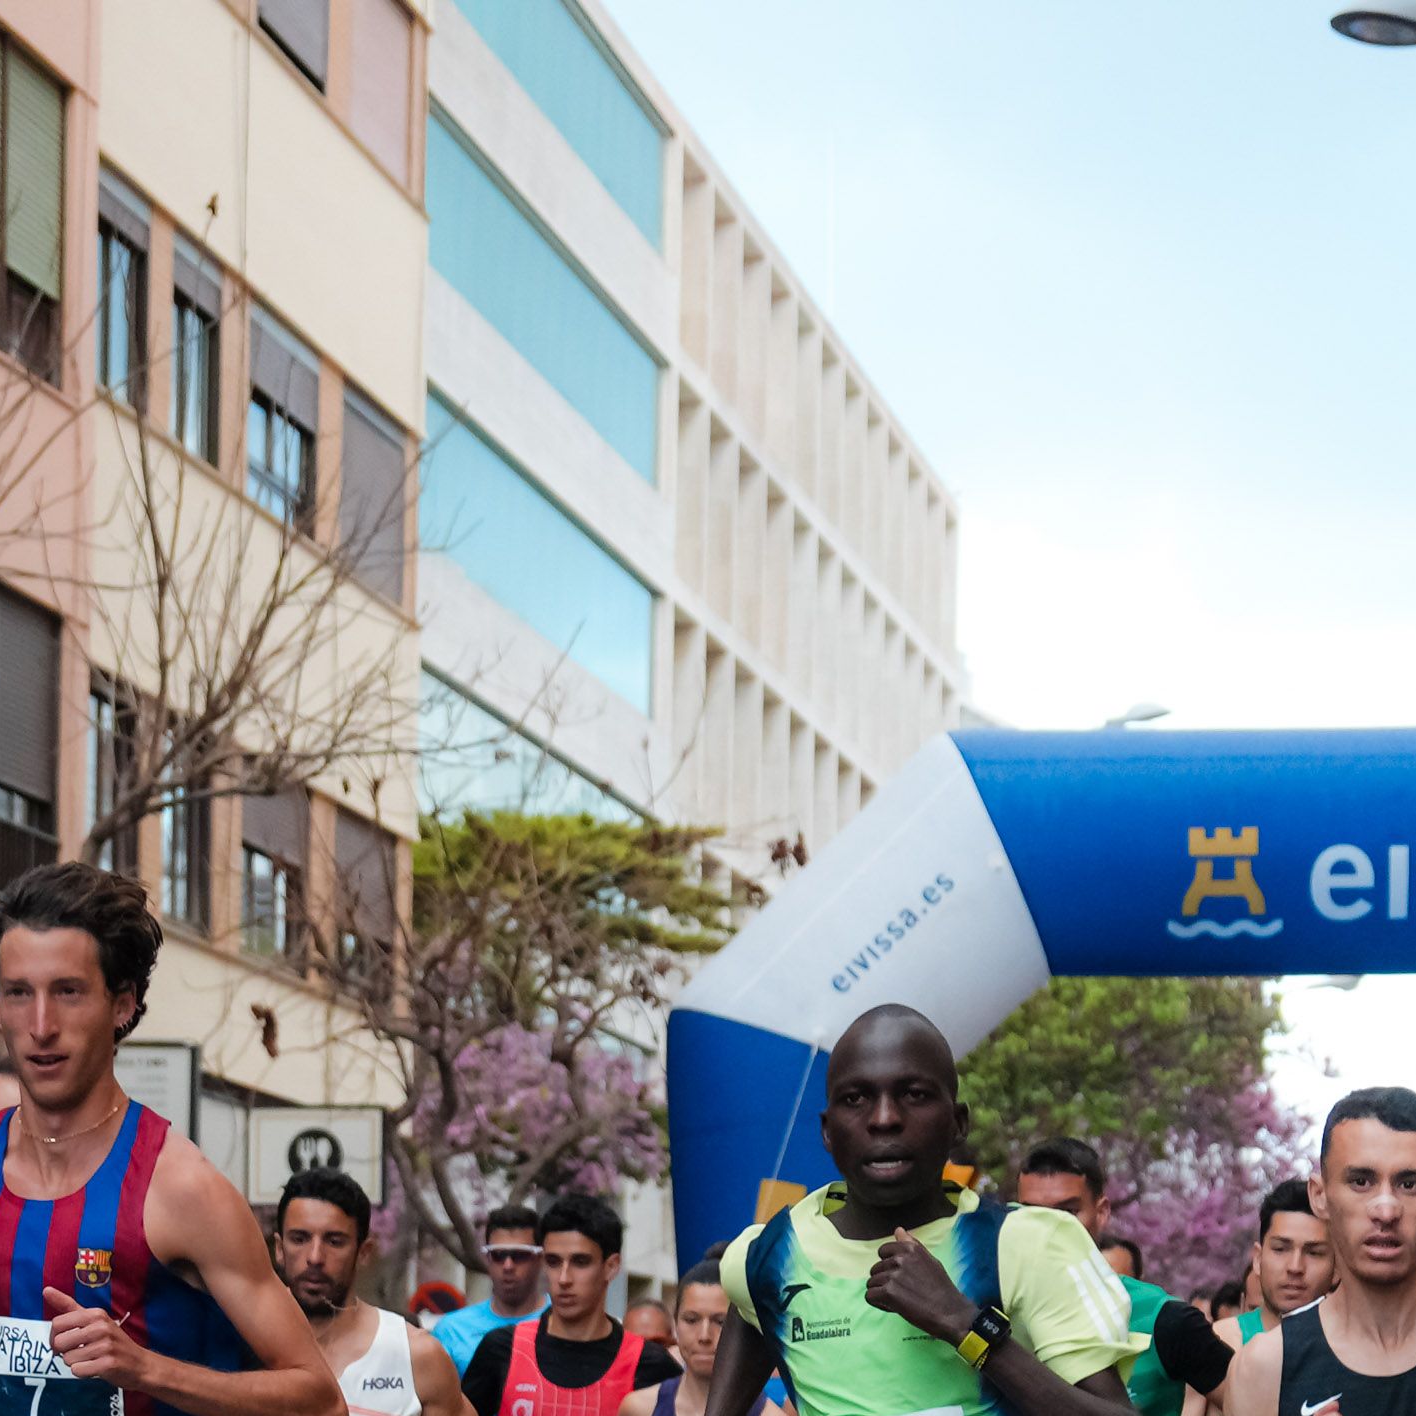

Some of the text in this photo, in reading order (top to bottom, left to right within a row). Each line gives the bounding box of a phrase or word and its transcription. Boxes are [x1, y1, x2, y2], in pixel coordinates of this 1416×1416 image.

[832, 873, 954, 992] eivissa.es
[807, 1327, 851, 1341] Guadalajara
[9, 1355, 61, 1375] IBIZA
[362, 1377, 404, 1391] HOKA
